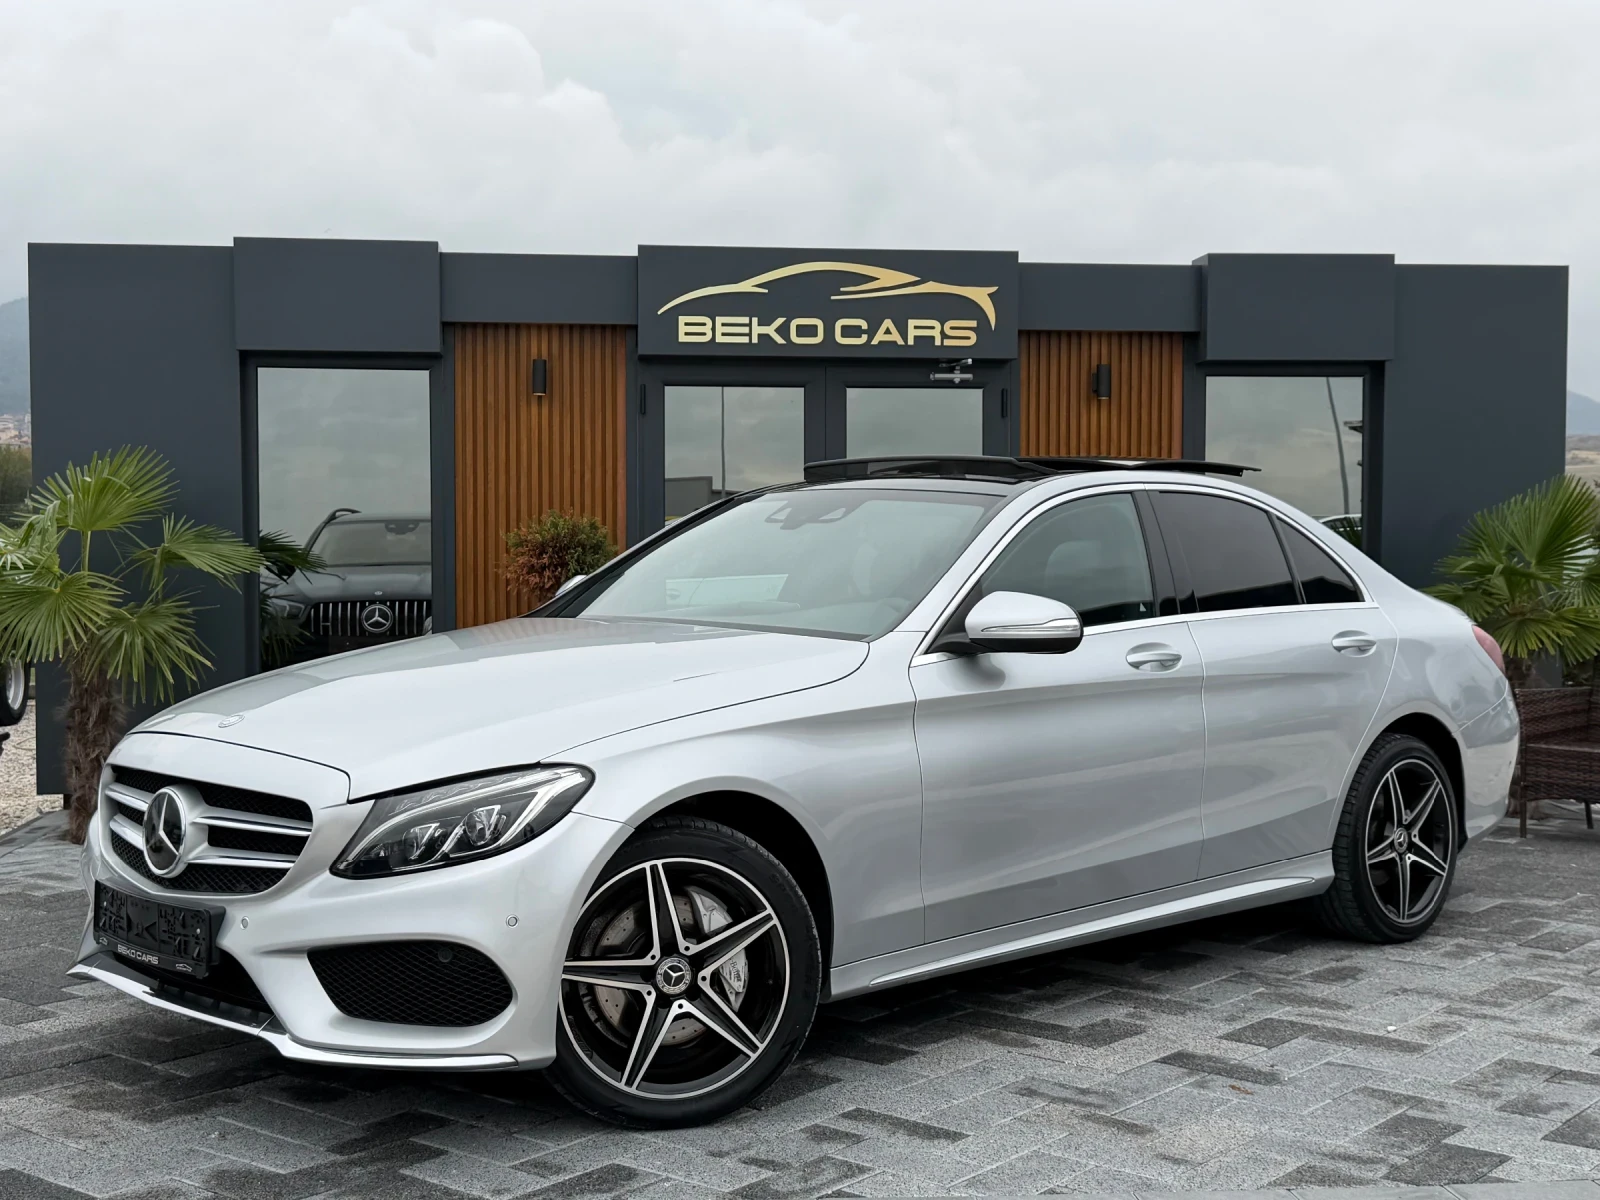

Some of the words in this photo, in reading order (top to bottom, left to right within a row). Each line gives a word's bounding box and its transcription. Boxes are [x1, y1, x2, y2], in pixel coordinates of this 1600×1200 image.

[678, 315, 824, 345] BEKO
[834, 318, 978, 347] CARS
[117, 944, 136, 958] BEKO
[136, 951, 159, 965] CARS
